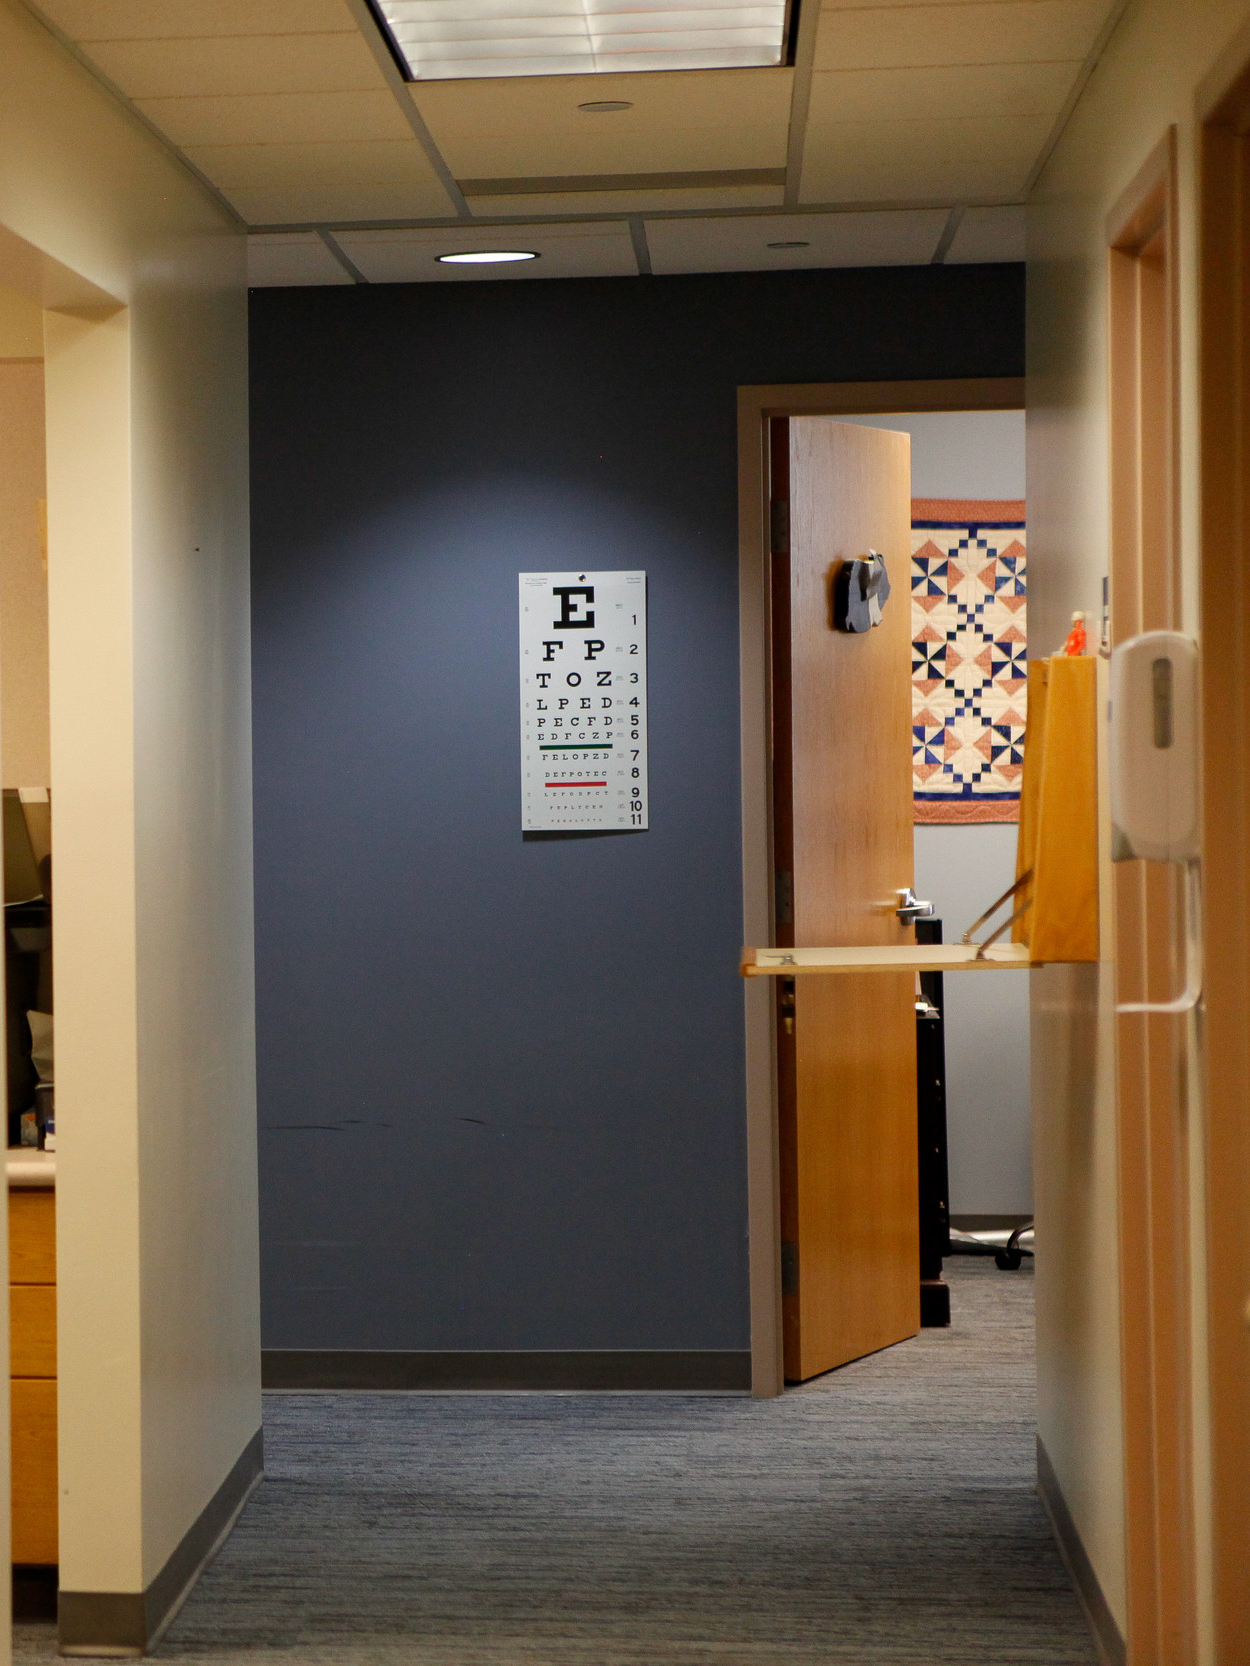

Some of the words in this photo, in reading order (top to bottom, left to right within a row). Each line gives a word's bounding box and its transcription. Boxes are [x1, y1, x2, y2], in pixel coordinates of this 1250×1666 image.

[553, 586, 595, 630] E
[631, 614, 637, 626] 1
[542, 640, 564, 662] F
[584, 639, 605, 661] P
[629, 644, 639, 655] 2
[536, 673, 552, 688] T
[566, 672, 582, 687] O
[596, 671, 612, 687] Z
[629, 673, 639, 684] 3
[629, 696, 640, 708] 4
[630, 714, 639, 726] 5
[630, 729, 639, 740] 6
[630, 749, 640, 761] 7
[631, 767, 640, 778] 8
[631, 787, 640, 798] 9
[629, 800, 643, 812] 10
[630, 814, 642, 825] 11
